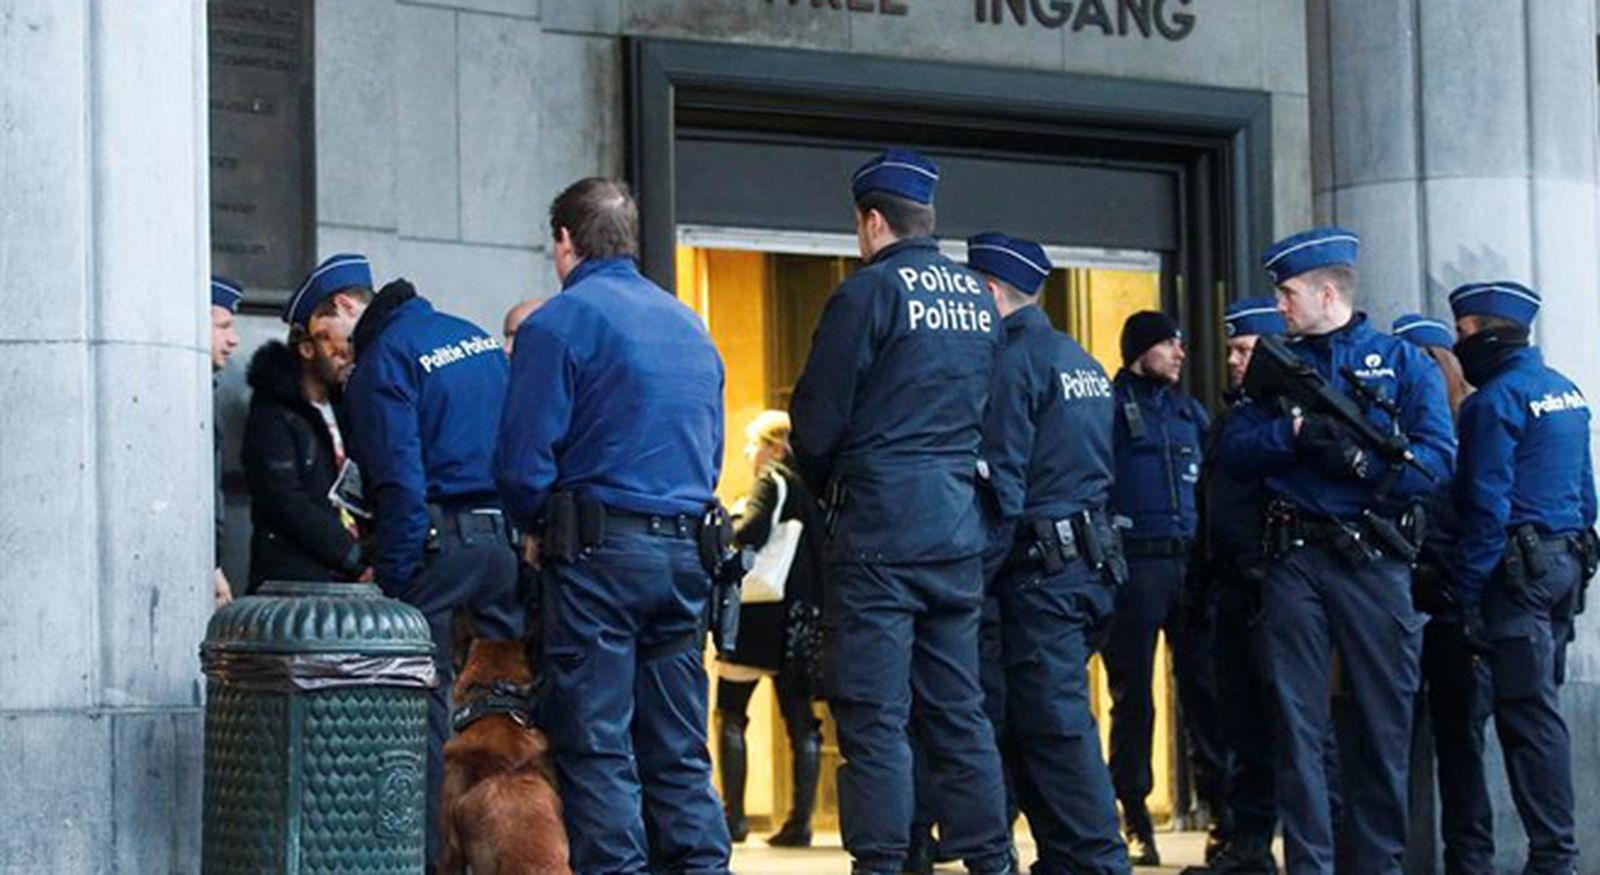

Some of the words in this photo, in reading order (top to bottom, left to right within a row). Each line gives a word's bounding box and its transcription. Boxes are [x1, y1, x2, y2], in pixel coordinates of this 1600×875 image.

[974, 0, 1196, 41] INGANG
[899, 266, 981, 295] Police
[908, 300, 992, 333] Politie
[1060, 369, 1111, 400] Politie
